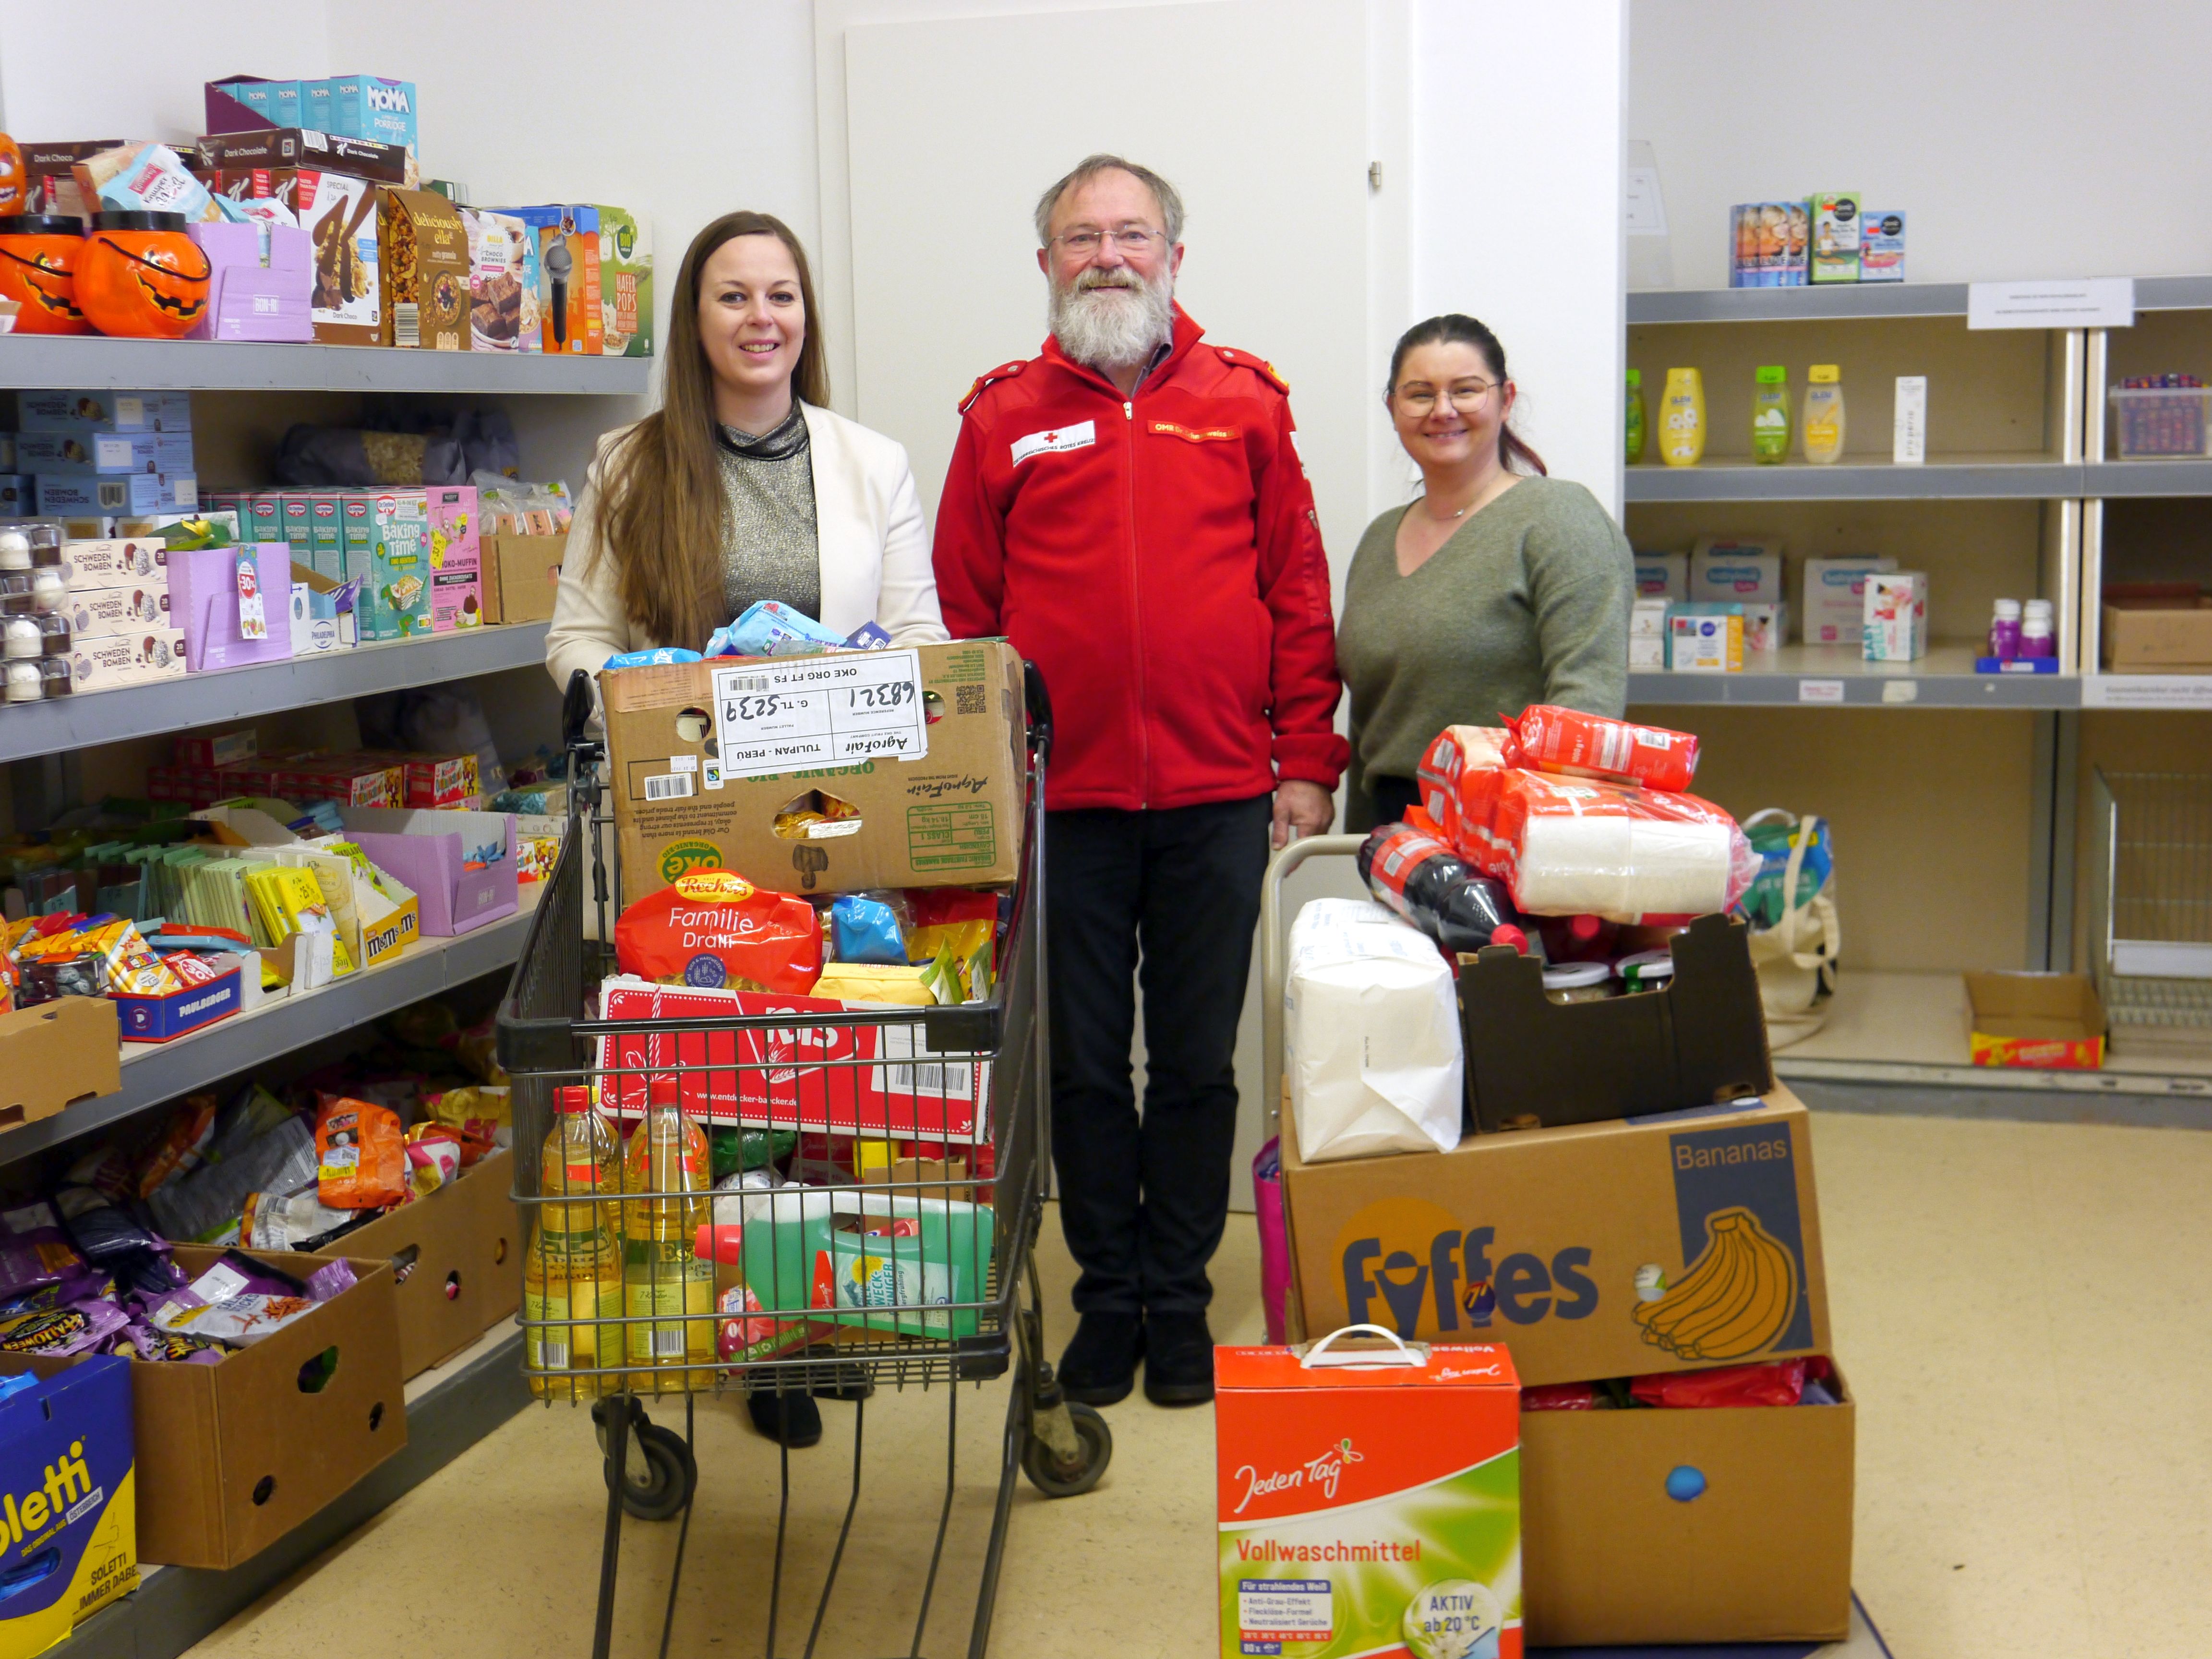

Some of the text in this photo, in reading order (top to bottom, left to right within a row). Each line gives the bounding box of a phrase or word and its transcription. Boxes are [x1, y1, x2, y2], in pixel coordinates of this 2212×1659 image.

[367, 85, 409, 113] MOMA
[374, 118, 406, 132] PORRIDGE
[225, 147, 267, 157] Dark Chocolate
[357, 150, 379, 159] Chocolate
[327, 181, 348, 191] SPECIAL
[414, 212, 462, 233] deliciously
[434, 230, 450, 244] ella
[620, 233, 630, 247] BIO
[616, 275, 636, 293] HAFER
[255, 298, 277, 313] BON-RI
[617, 293, 637, 312] POPS
[383, 523, 420, 541] Baking
[389, 539, 416, 555] Time
[74, 553, 111, 563] SCHWEDEN
[84, 562, 111, 571] BOMBEN
[240, 577, 255, 589] -30%
[90, 601, 121, 611] SCHWEDEN
[98, 609, 122, 619] BOMBEN
[313, 630, 334, 639] PHILADELPHIA
[93, 648, 130, 660] SCHWEDEN
[103, 657, 131, 667] BOMBEN
[791, 673, 803, 681] FT
[835, 668, 856, 677] OKE
[851, 682, 914, 707] 68321
[846, 738, 907, 752] AgroFair
[737, 745, 820, 761] TULIPAN PERÚ
[907, 774, 988, 798] AgroFair
[713, 802, 735, 810] people
[656, 814, 676, 822] planet
[673, 820, 707, 828] represents
[669, 908, 753, 932] Familie
[683, 932, 732, 948] Dralli
[699, 956, 723, 971] HARTWEIZEN
[179, 988, 230, 1017] PAULBERGER
[1676, 1138, 1789, 1170] Bananas
[1344, 1226, 1599, 1341] fyffes
[1234, 1452, 1341, 1513] Jeden Tag
[22, 1492, 100, 1557] DAS ORIGINAL AUS ÖSTERREICH
[1237, 1539, 1420, 1561] Vollwaschmittel
[91, 1552, 126, 1586] SOLETTI
[1242, 1582, 1327, 1591] Für strahlendes Weiß
[1430, 1596, 1473, 1611] AKTIV
[1424, 1616, 1440, 1632] ab
[1444, 1616, 1461, 1631] 20
